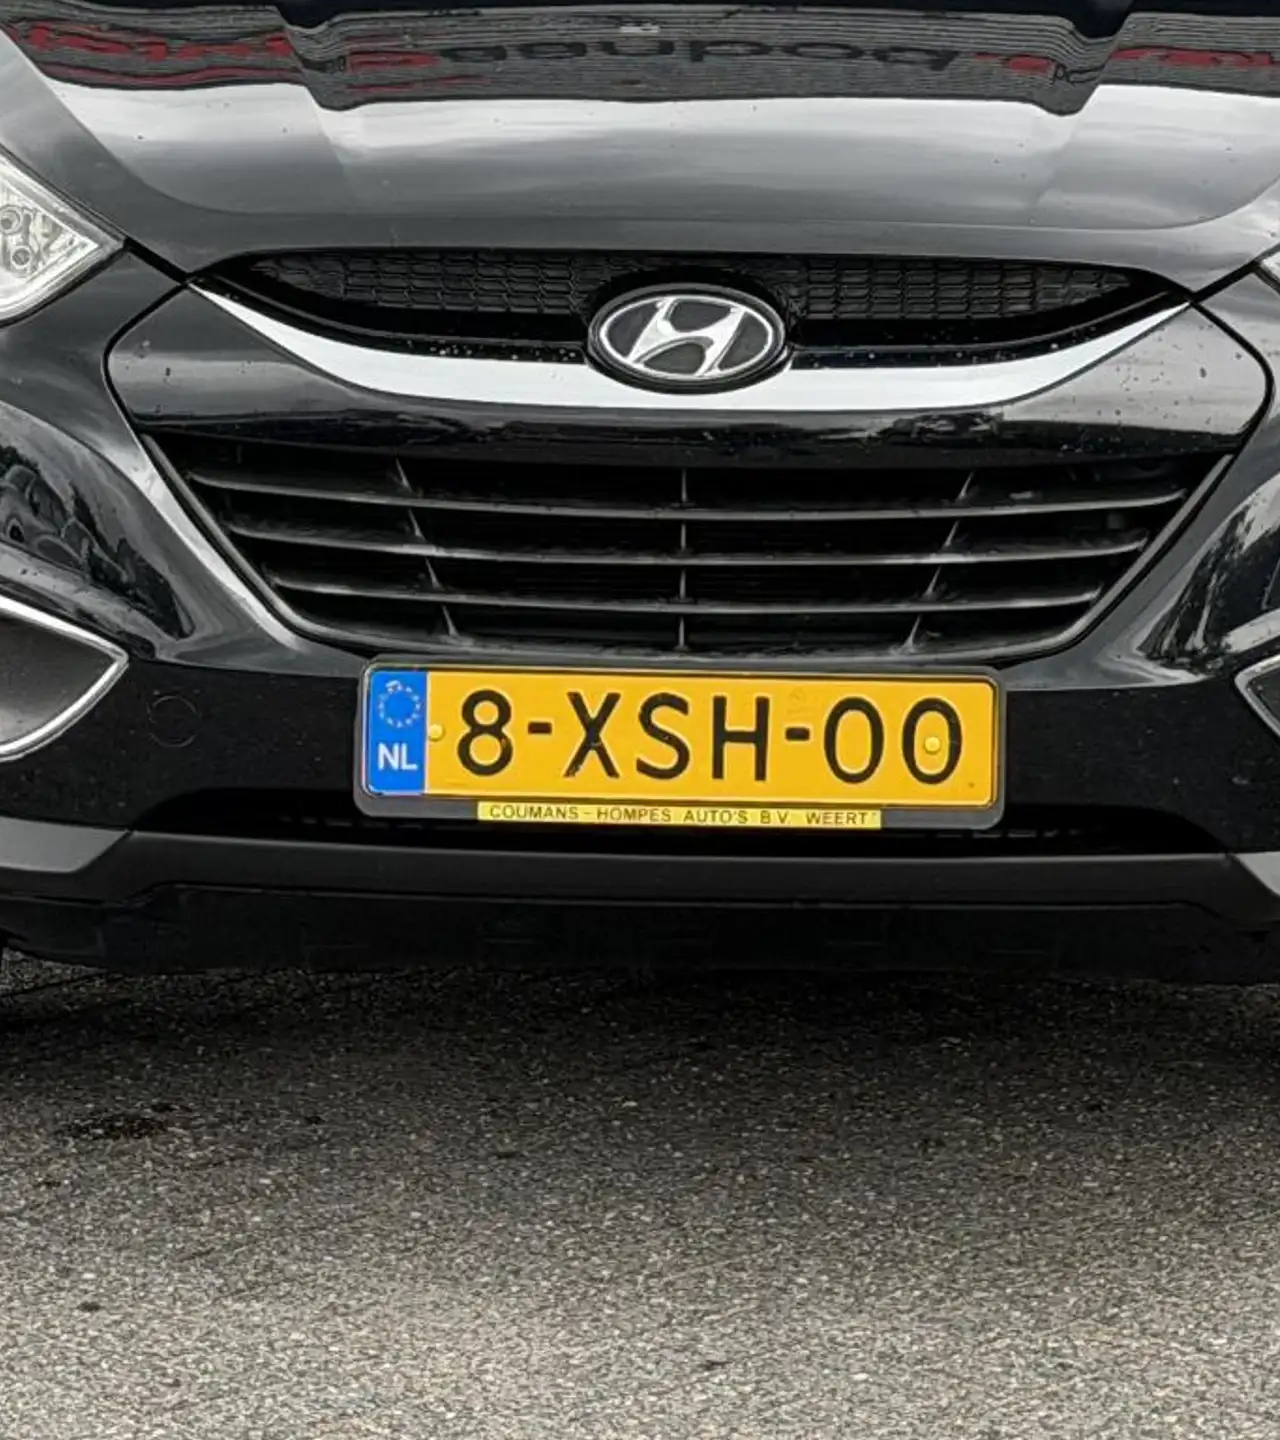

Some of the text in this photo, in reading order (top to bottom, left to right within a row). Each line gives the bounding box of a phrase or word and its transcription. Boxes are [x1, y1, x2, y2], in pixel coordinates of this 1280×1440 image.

[456, 688, 963, 786] 8-XSH-00
[378, 742, 419, 771] NL
[683, 809, 749, 823] AUTO'S
[806, 811, 868, 825] WEERT
